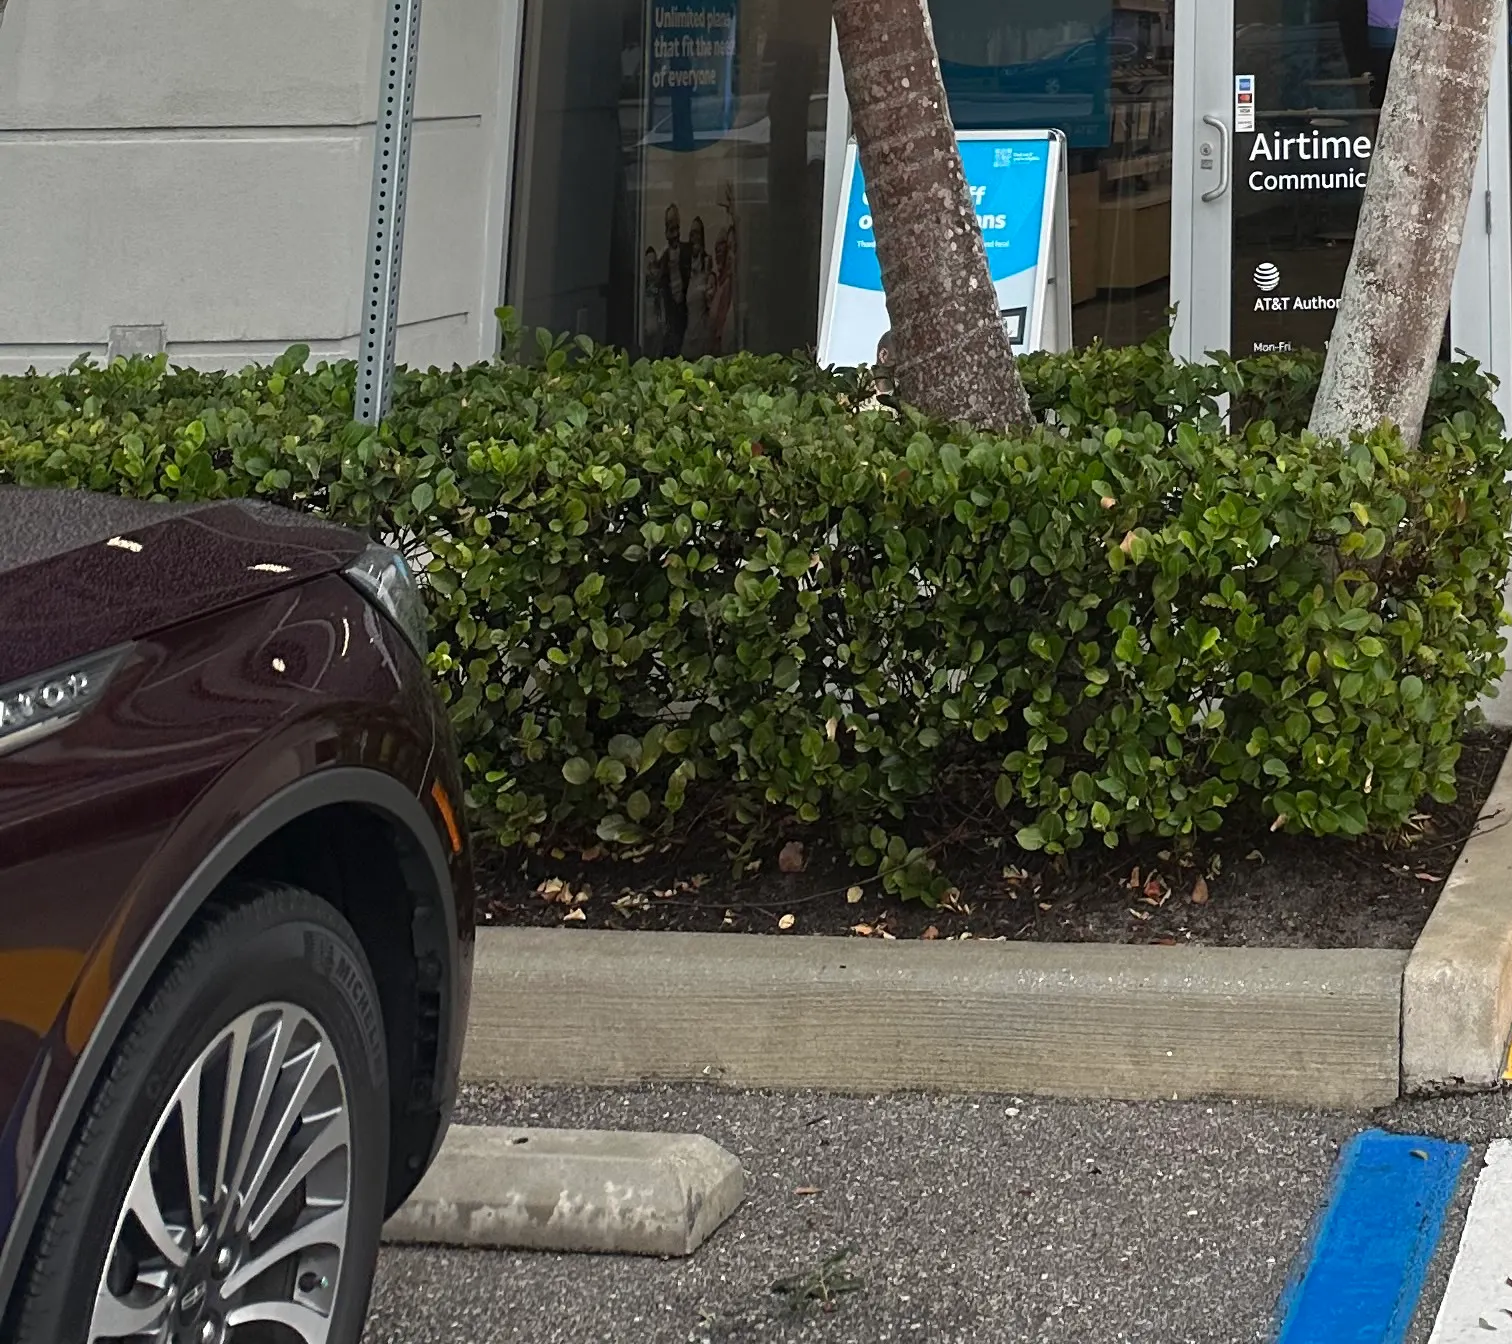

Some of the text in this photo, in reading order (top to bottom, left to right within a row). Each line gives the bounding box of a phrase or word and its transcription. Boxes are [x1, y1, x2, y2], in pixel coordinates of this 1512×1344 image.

[656, 4, 705, 28] Unlimited
[654, 34, 680, 57] that
[682, 34, 694, 57] fit
[695, 35, 713, 56] the
[652, 65, 716, 92] of everyone
[1248, 130, 1371, 160] Airtime
[1254, 297, 1290, 311] AT&T
[1253, 341, 1291, 352] Mon-Fri
